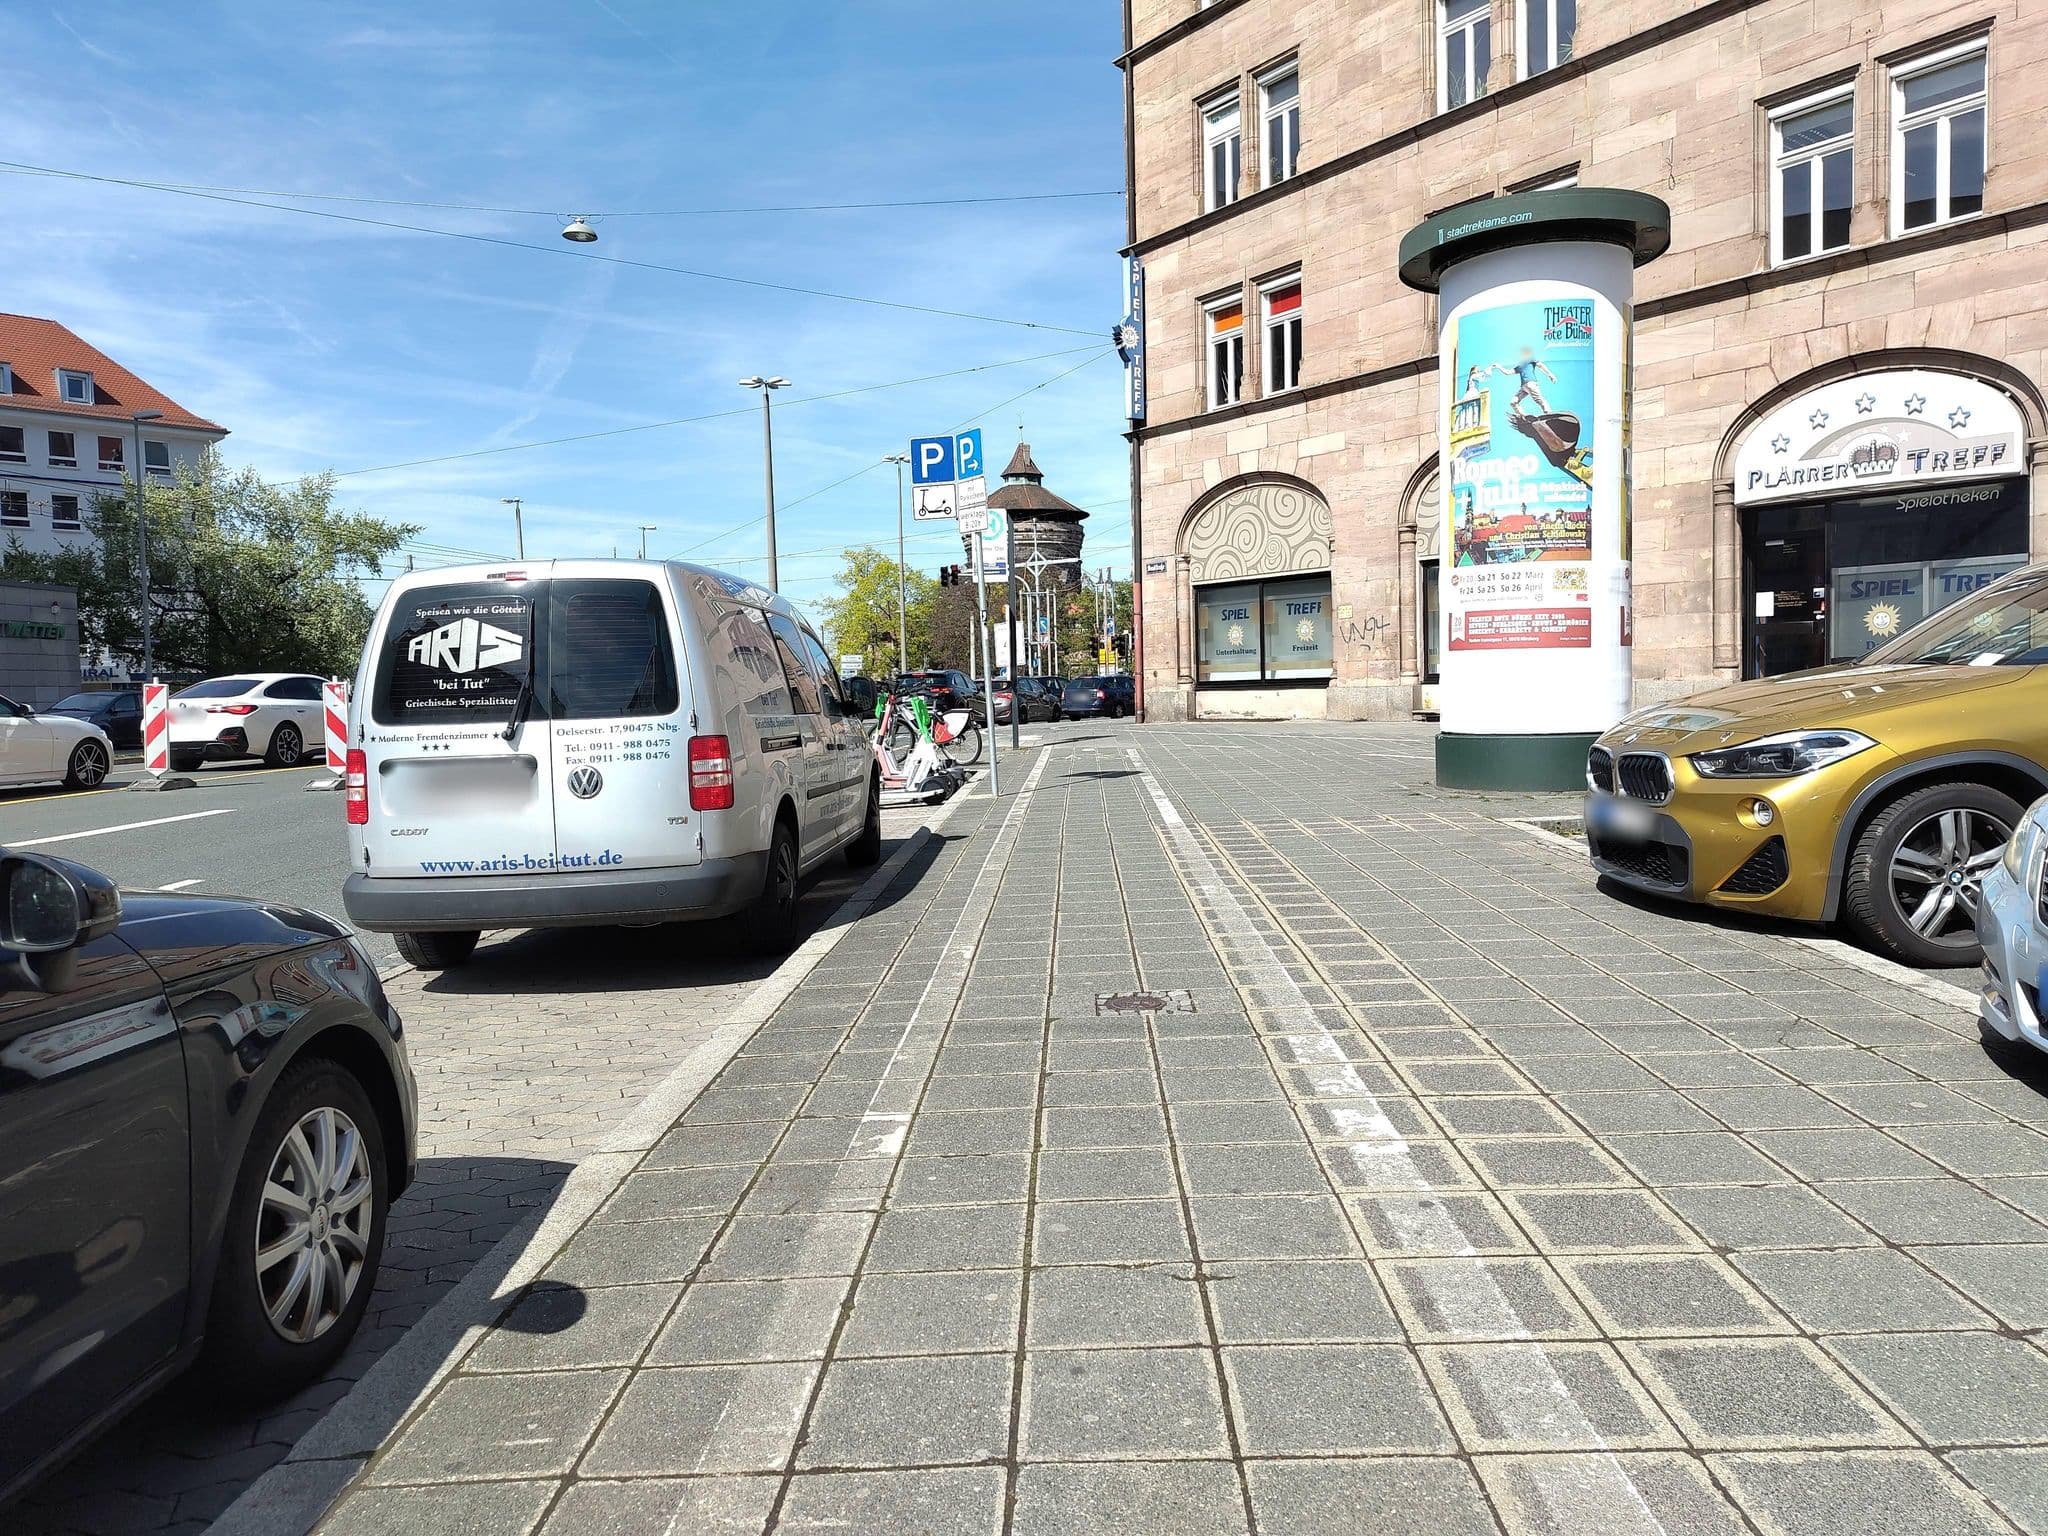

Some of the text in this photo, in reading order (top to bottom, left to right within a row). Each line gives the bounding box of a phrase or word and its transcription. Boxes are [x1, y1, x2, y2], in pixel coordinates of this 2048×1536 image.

[1446, 212, 1533, 239] stadtreklame.com
[1132, 260, 1140, 322] SPIEL
[1544, 306, 1592, 330] THEATER
[1565, 322, 1592, 340] Bühne
[1133, 354, 1142, 414] TREFF
[921, 443, 944, 478] P
[959, 437, 974, 474] P
[1453, 454, 1540, 483] Romeo
[1747, 443, 2007, 490] PLÄRRER TREFF
[1896, 488, 2000, 512] Spielotheken
[1523, 523, 1538, 531] von
[1505, 530, 1540, 541] Christian
[1477, 574, 1485, 582] Sa
[1487, 573, 1496, 581] 21
[1500, 572, 1510, 580] So
[1511, 572, 1521, 580] 22
[1477, 586, 1485, 594] Sa
[1487, 585, 1496, 593] 25
[1500, 584, 1510, 592] So
[1511, 584, 1521, 592] 26
[1851, 578, 1915, 599] SPIEL
[416, 604, 526, 618] Speisen wie die Götter!
[1221, 608, 1250, 621] SPIEL
[408, 617, 523, 673] ARIS
[1215, 643, 1319, 656] Unterhaltung Freizeit
[433, 677, 490, 690] "bei Tut"
[405, 698, 457, 708] Griechische
[656, 722, 681, 733] Nbg.
[378, 732, 488, 743] Moderne Fremdenzimmer
[564, 743, 587, 753] Tel.:
[589, 742, 613, 751] 0911
[623, 740, 643, 749] 988
[646, 738, 671, 748] 0475
[565, 756, 586, 765] Fax:
[589, 753, 613, 763] 0911
[623, 752, 642, 761] 988
[645, 751, 670, 760] 0476
[667, 816, 688, 825] TDI
[390, 828, 429, 837] CADDY
[420, 849, 623, 873] www.aris-bei-tut.de
